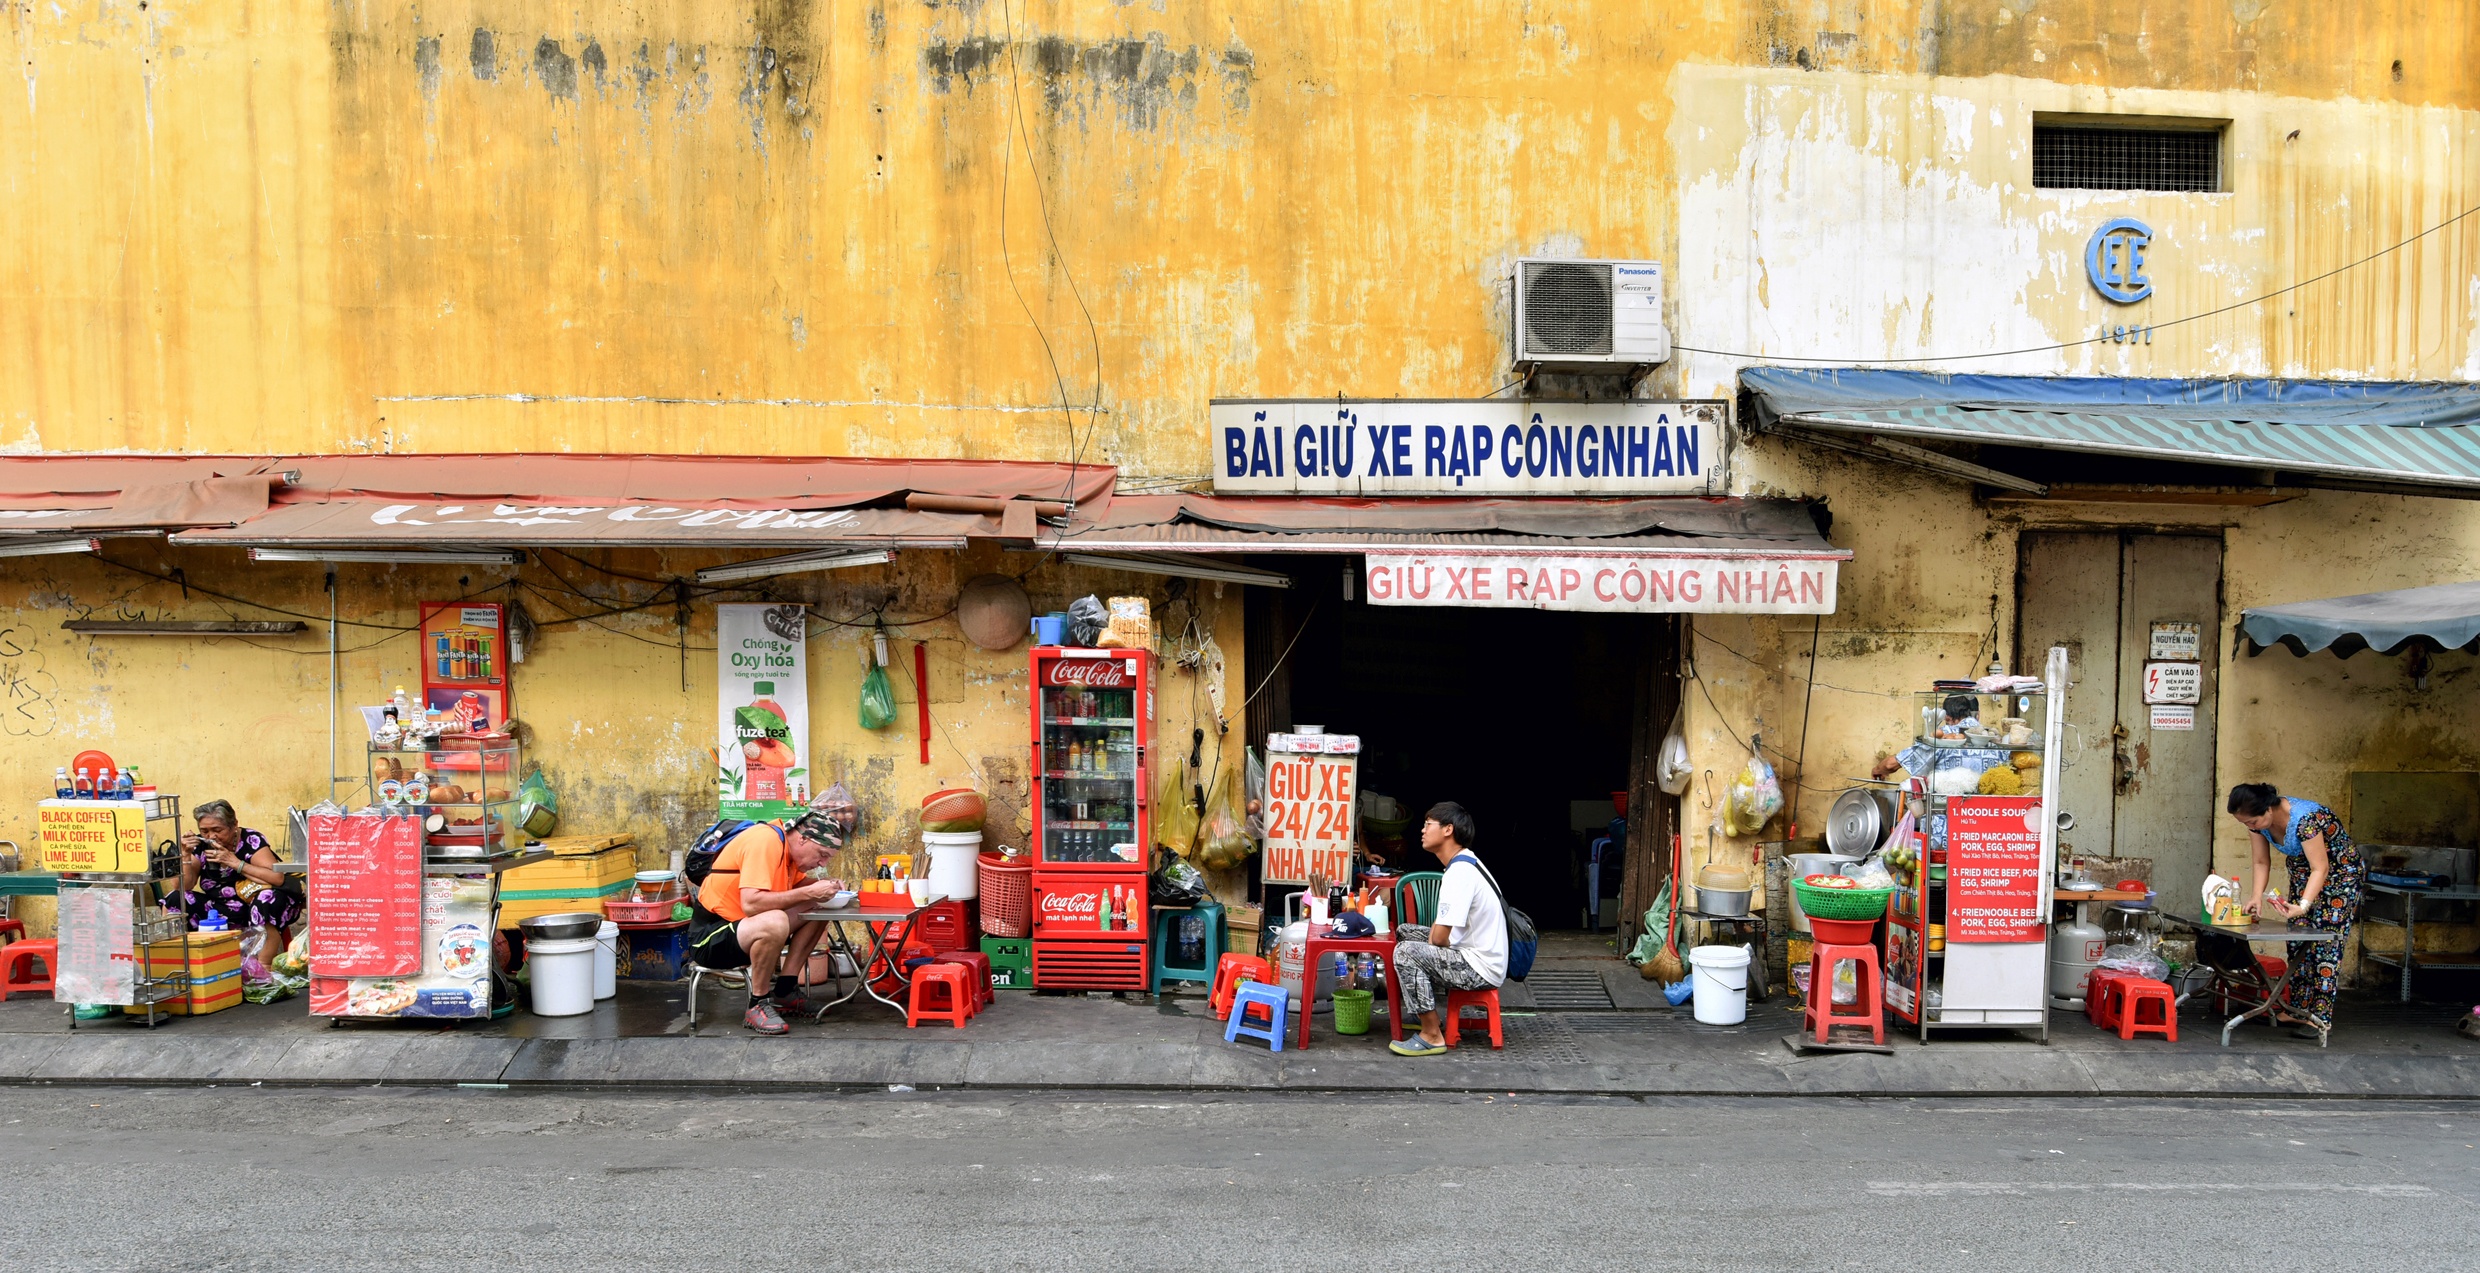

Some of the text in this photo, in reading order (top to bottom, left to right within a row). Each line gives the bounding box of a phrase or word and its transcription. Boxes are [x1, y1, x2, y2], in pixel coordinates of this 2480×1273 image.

[1618, 268, 1656, 276] Panasonic
[2101, 324, 2153, 345] 1971
[1224, 408, 1699, 487] BÃI GIỮ XE RẠP CÔNGNHÂN
[1367, 560, 1825, 609] GIỮ XE RẠP CÔNG NHÂN
[767, 613, 799, 637] CHIA
[742, 637, 778, 651] Chống
[450, 651, 466, 659] FANTA
[731, 652, 794, 670] Oxy hóa
[1050, 660, 1126, 686] Coca-Cola
[2165, 666, 2179, 676] CẤM
[2181, 666, 2194, 676] VÀO
[1269, 756, 1352, 802] GIỮ XE
[42, 811, 112, 824] BLACK COFFEE
[1952, 808, 2027, 817] 1. NOODLE SOUP
[1268, 801, 1350, 840] 24/24
[43, 831, 106, 842] MILK COFFEE
[120, 829, 144, 838] HOT
[1952, 832, 1958, 841] 2.
[1960, 832, 1980, 841] FRIED
[1982, 833, 2024, 841] MARCARONI
[123, 843, 142, 852] ICE
[1961, 842, 2036, 852] PORK, EGG, SHRIMP
[45, 851, 96, 862] LIME JUICE
[1267, 841, 1348, 882] NHÀ HÁT
[1952, 868, 1958, 877] 3.
[1960, 868, 1982, 877] FRIED
[1983, 868, 1999, 877] RICE
[2002, 868, 2021, 878] BEEF,
[1960, 879, 2010, 888] EGG, SHRIMP
[1042, 892, 1098, 912] Coca-Cola
[1062, 914, 1077, 922] lạnh
[1961, 908, 2018, 917] FRIEDNOOBLE
[423, 917, 445, 926] ngon!
[1961, 919, 2008, 928] PORK, EGG,
[71, 928, 96, 966] COFFEE
